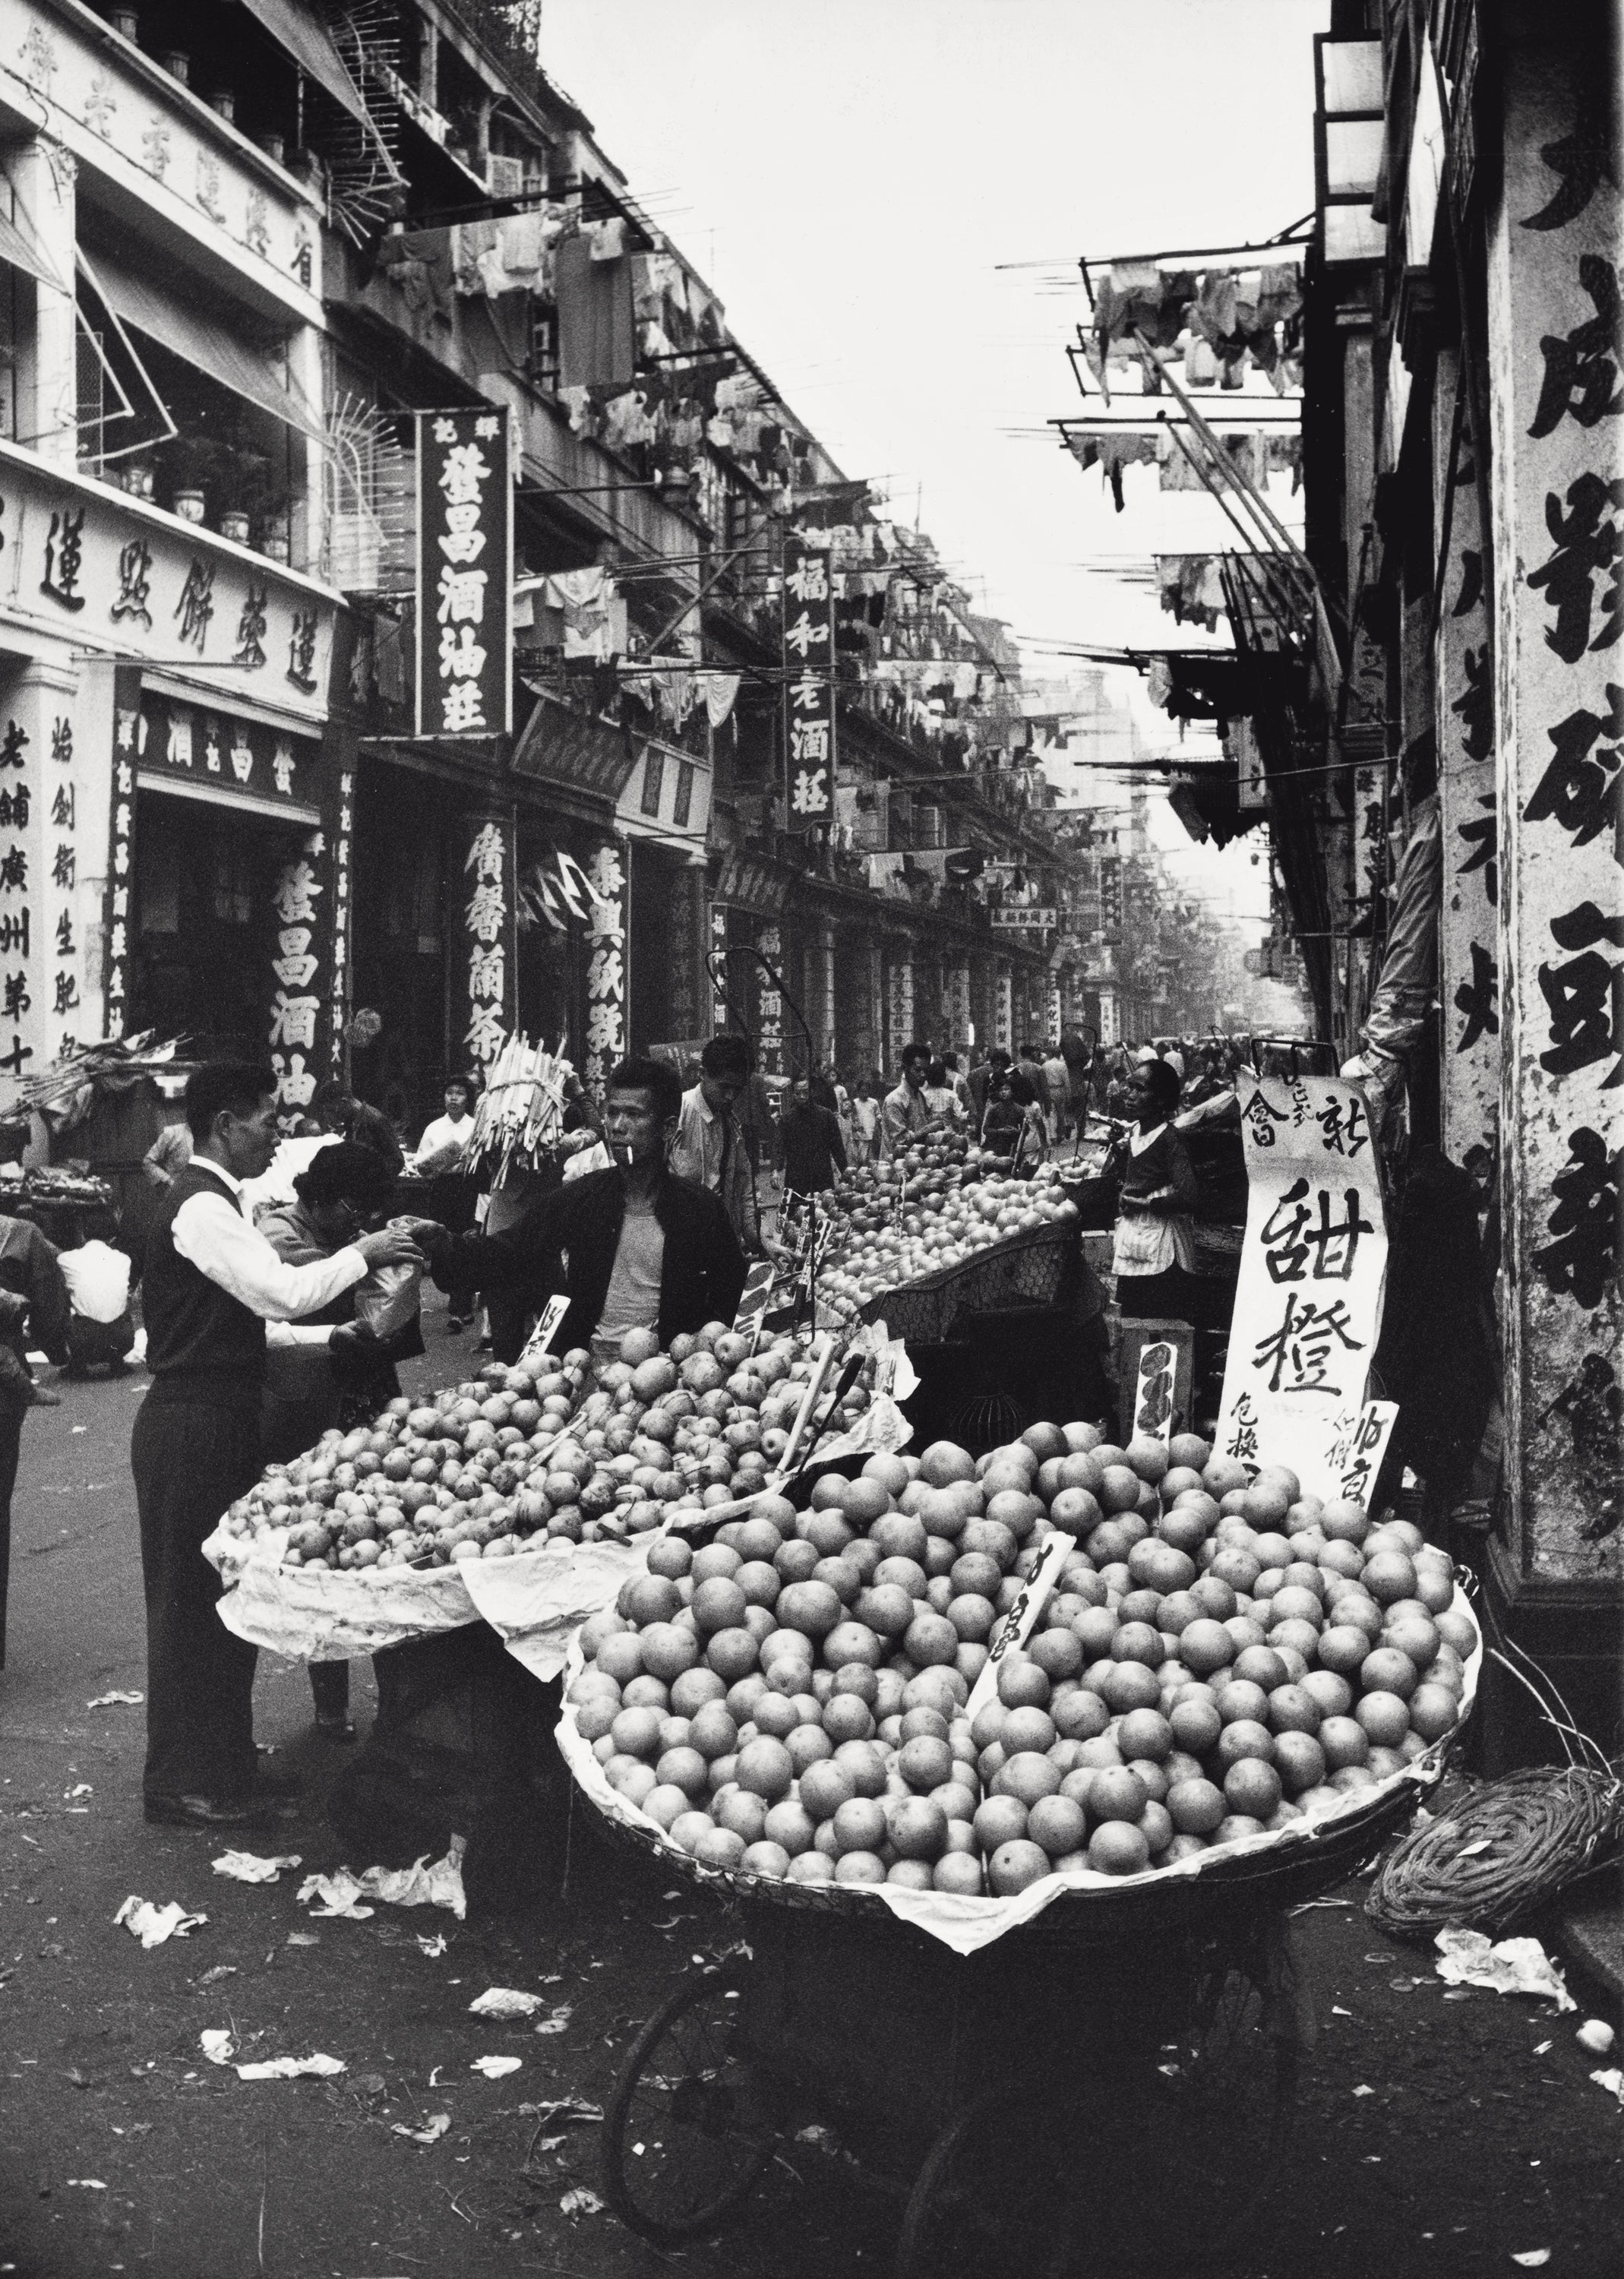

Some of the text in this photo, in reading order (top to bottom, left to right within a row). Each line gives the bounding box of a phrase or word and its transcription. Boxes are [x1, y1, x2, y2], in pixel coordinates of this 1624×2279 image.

[1241, 1088, 1369, 1158] 新會
[1251, 1177, 1374, 1396] 甜橙
[1225, 1392, 1259, 1459] 包換
